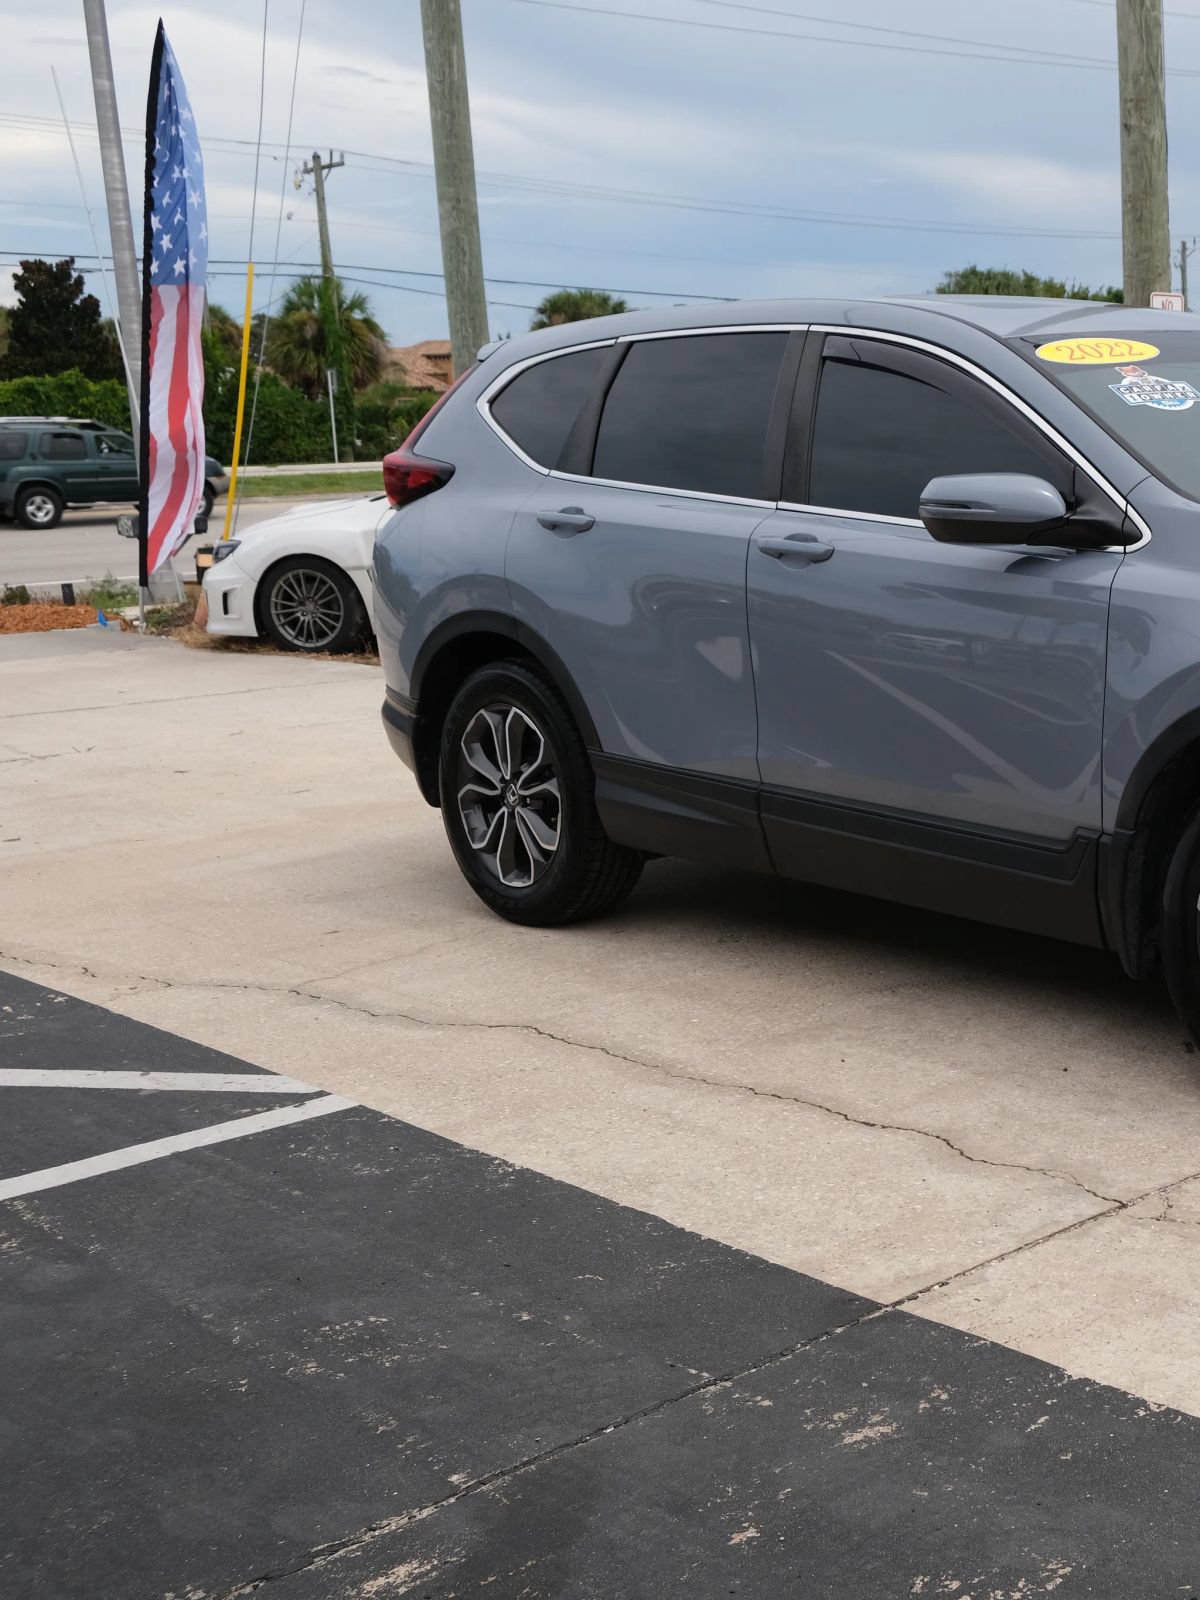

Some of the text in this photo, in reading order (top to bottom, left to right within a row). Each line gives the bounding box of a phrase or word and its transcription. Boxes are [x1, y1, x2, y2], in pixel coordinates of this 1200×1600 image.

[1056, 342, 1144, 361] 2022
[1118, 383, 1193, 394] CARFAX
[1139, 391, 1198, 401] OWNER
